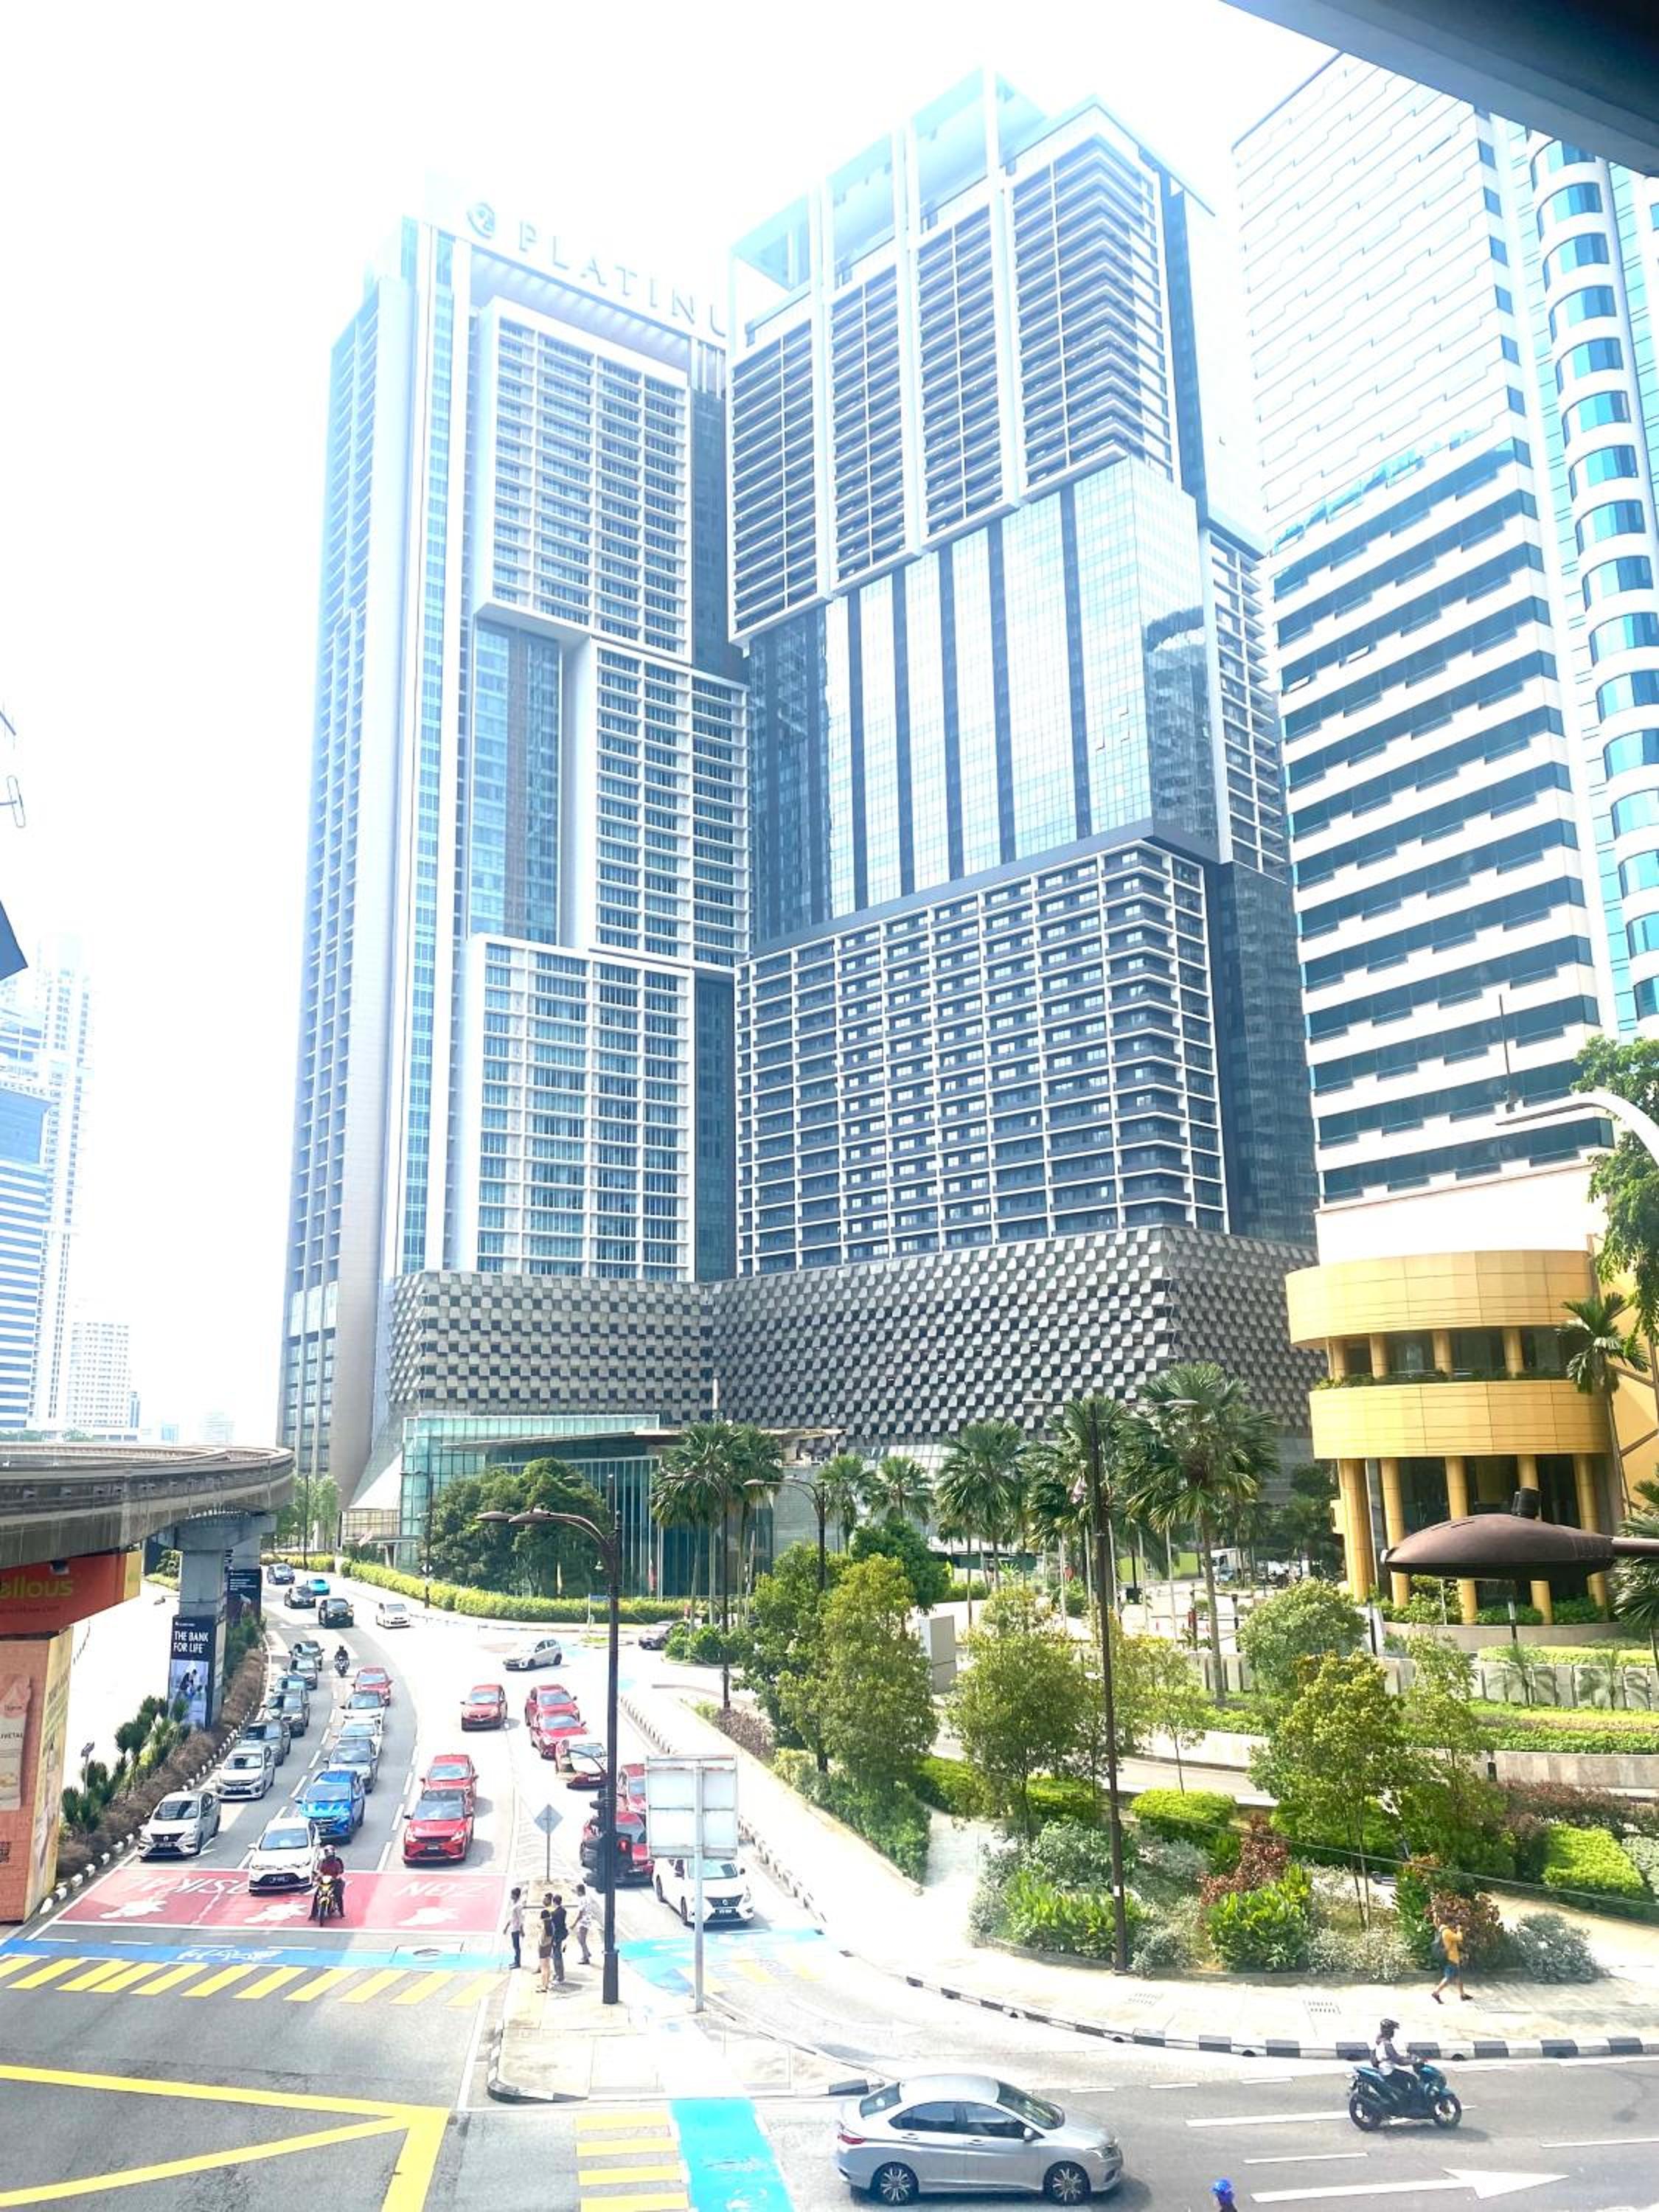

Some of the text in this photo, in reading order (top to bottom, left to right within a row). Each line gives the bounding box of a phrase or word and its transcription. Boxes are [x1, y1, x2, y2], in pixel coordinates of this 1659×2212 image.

[174, 1630, 209, 1642] THE BANK
[173, 1642, 203, 1654] FOR LIFE
